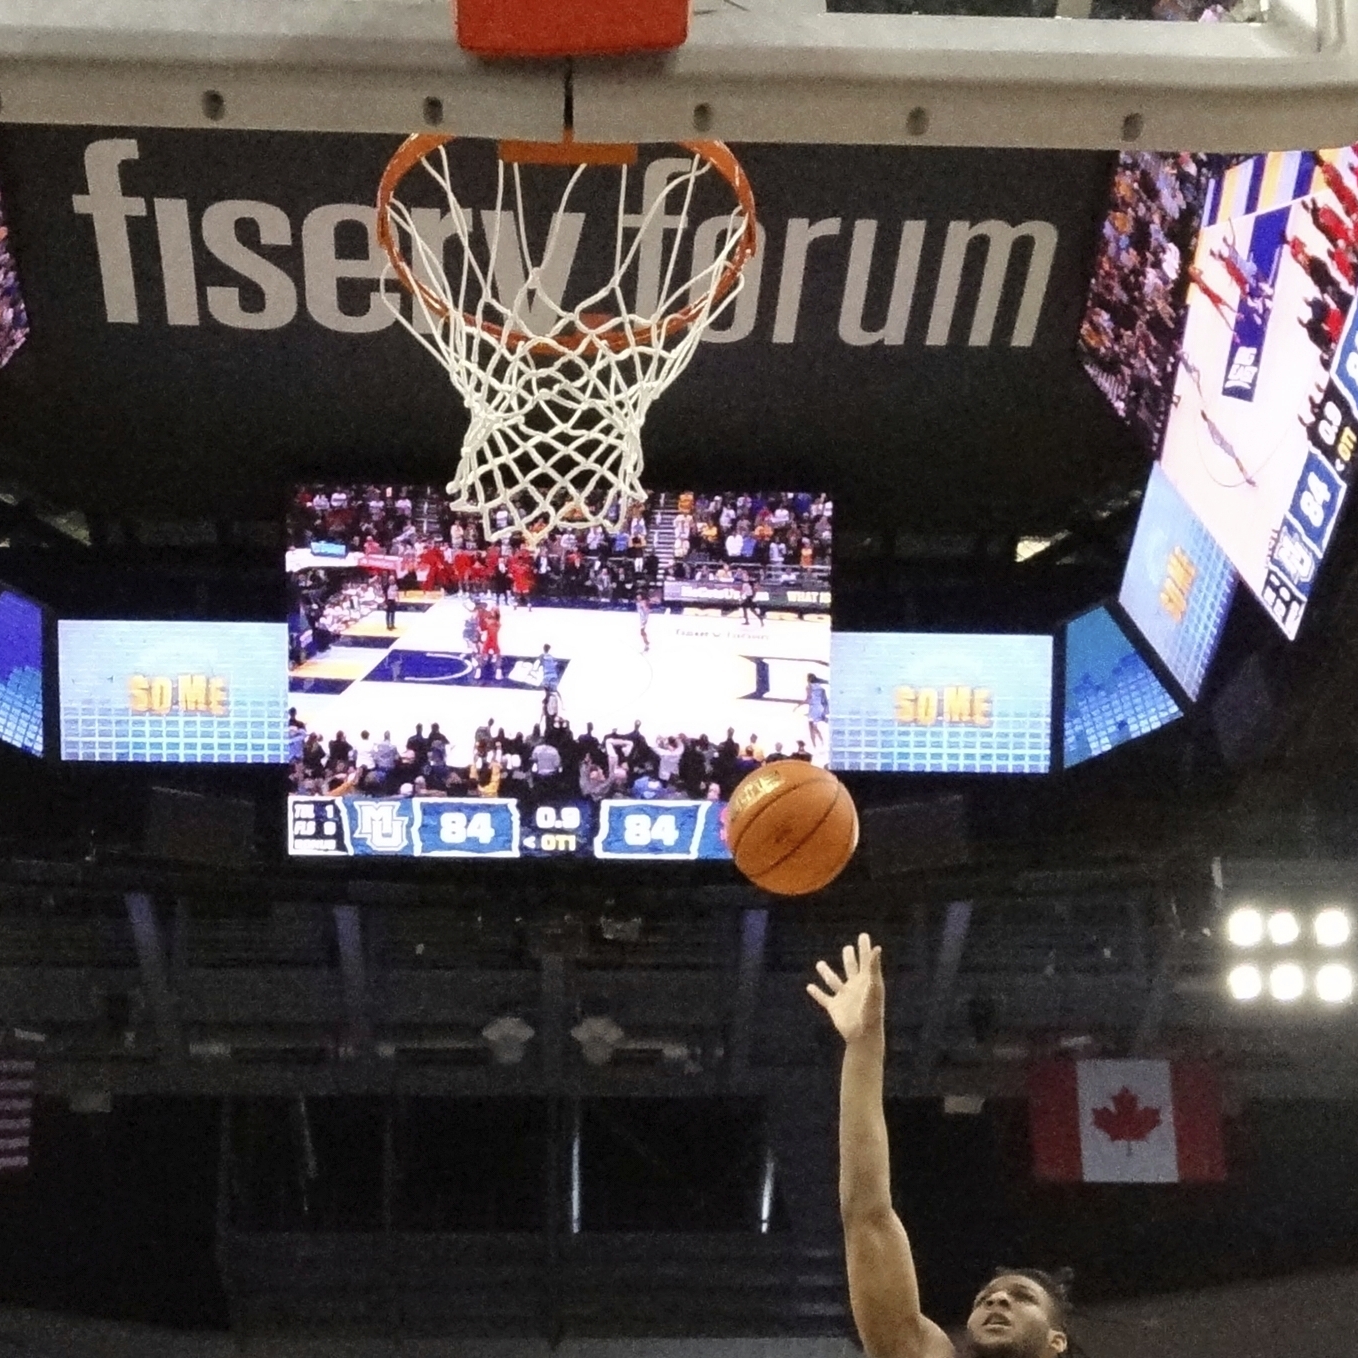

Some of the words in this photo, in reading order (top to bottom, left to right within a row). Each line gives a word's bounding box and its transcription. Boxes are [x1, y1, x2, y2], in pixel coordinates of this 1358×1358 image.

[72, 138, 585, 335] fiserv
[621, 157, 1060, 348] forum
[1299, 471, 1332, 528] 84
[440, 812, 495, 844] 84
[535, 806, 581, 829] 0.9
[624, 814, 679, 846] 84
